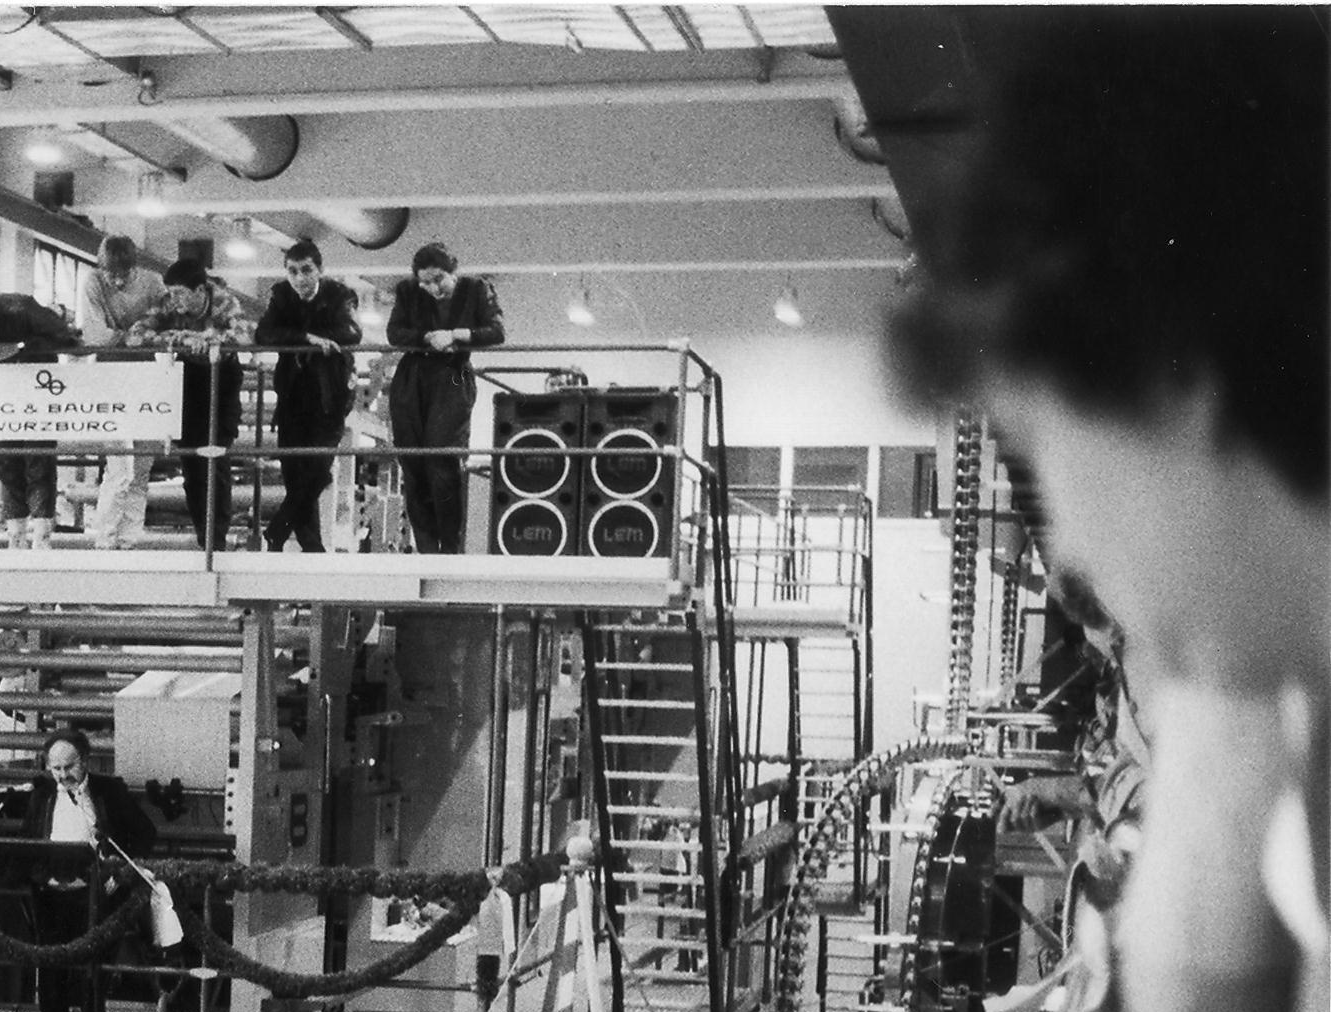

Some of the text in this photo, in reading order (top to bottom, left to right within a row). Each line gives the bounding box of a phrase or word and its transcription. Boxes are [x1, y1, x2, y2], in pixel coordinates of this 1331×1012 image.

[23, 402, 37, 414] &
[48, 402, 127, 414] BAUER
[138, 402, 173, 414] AG
